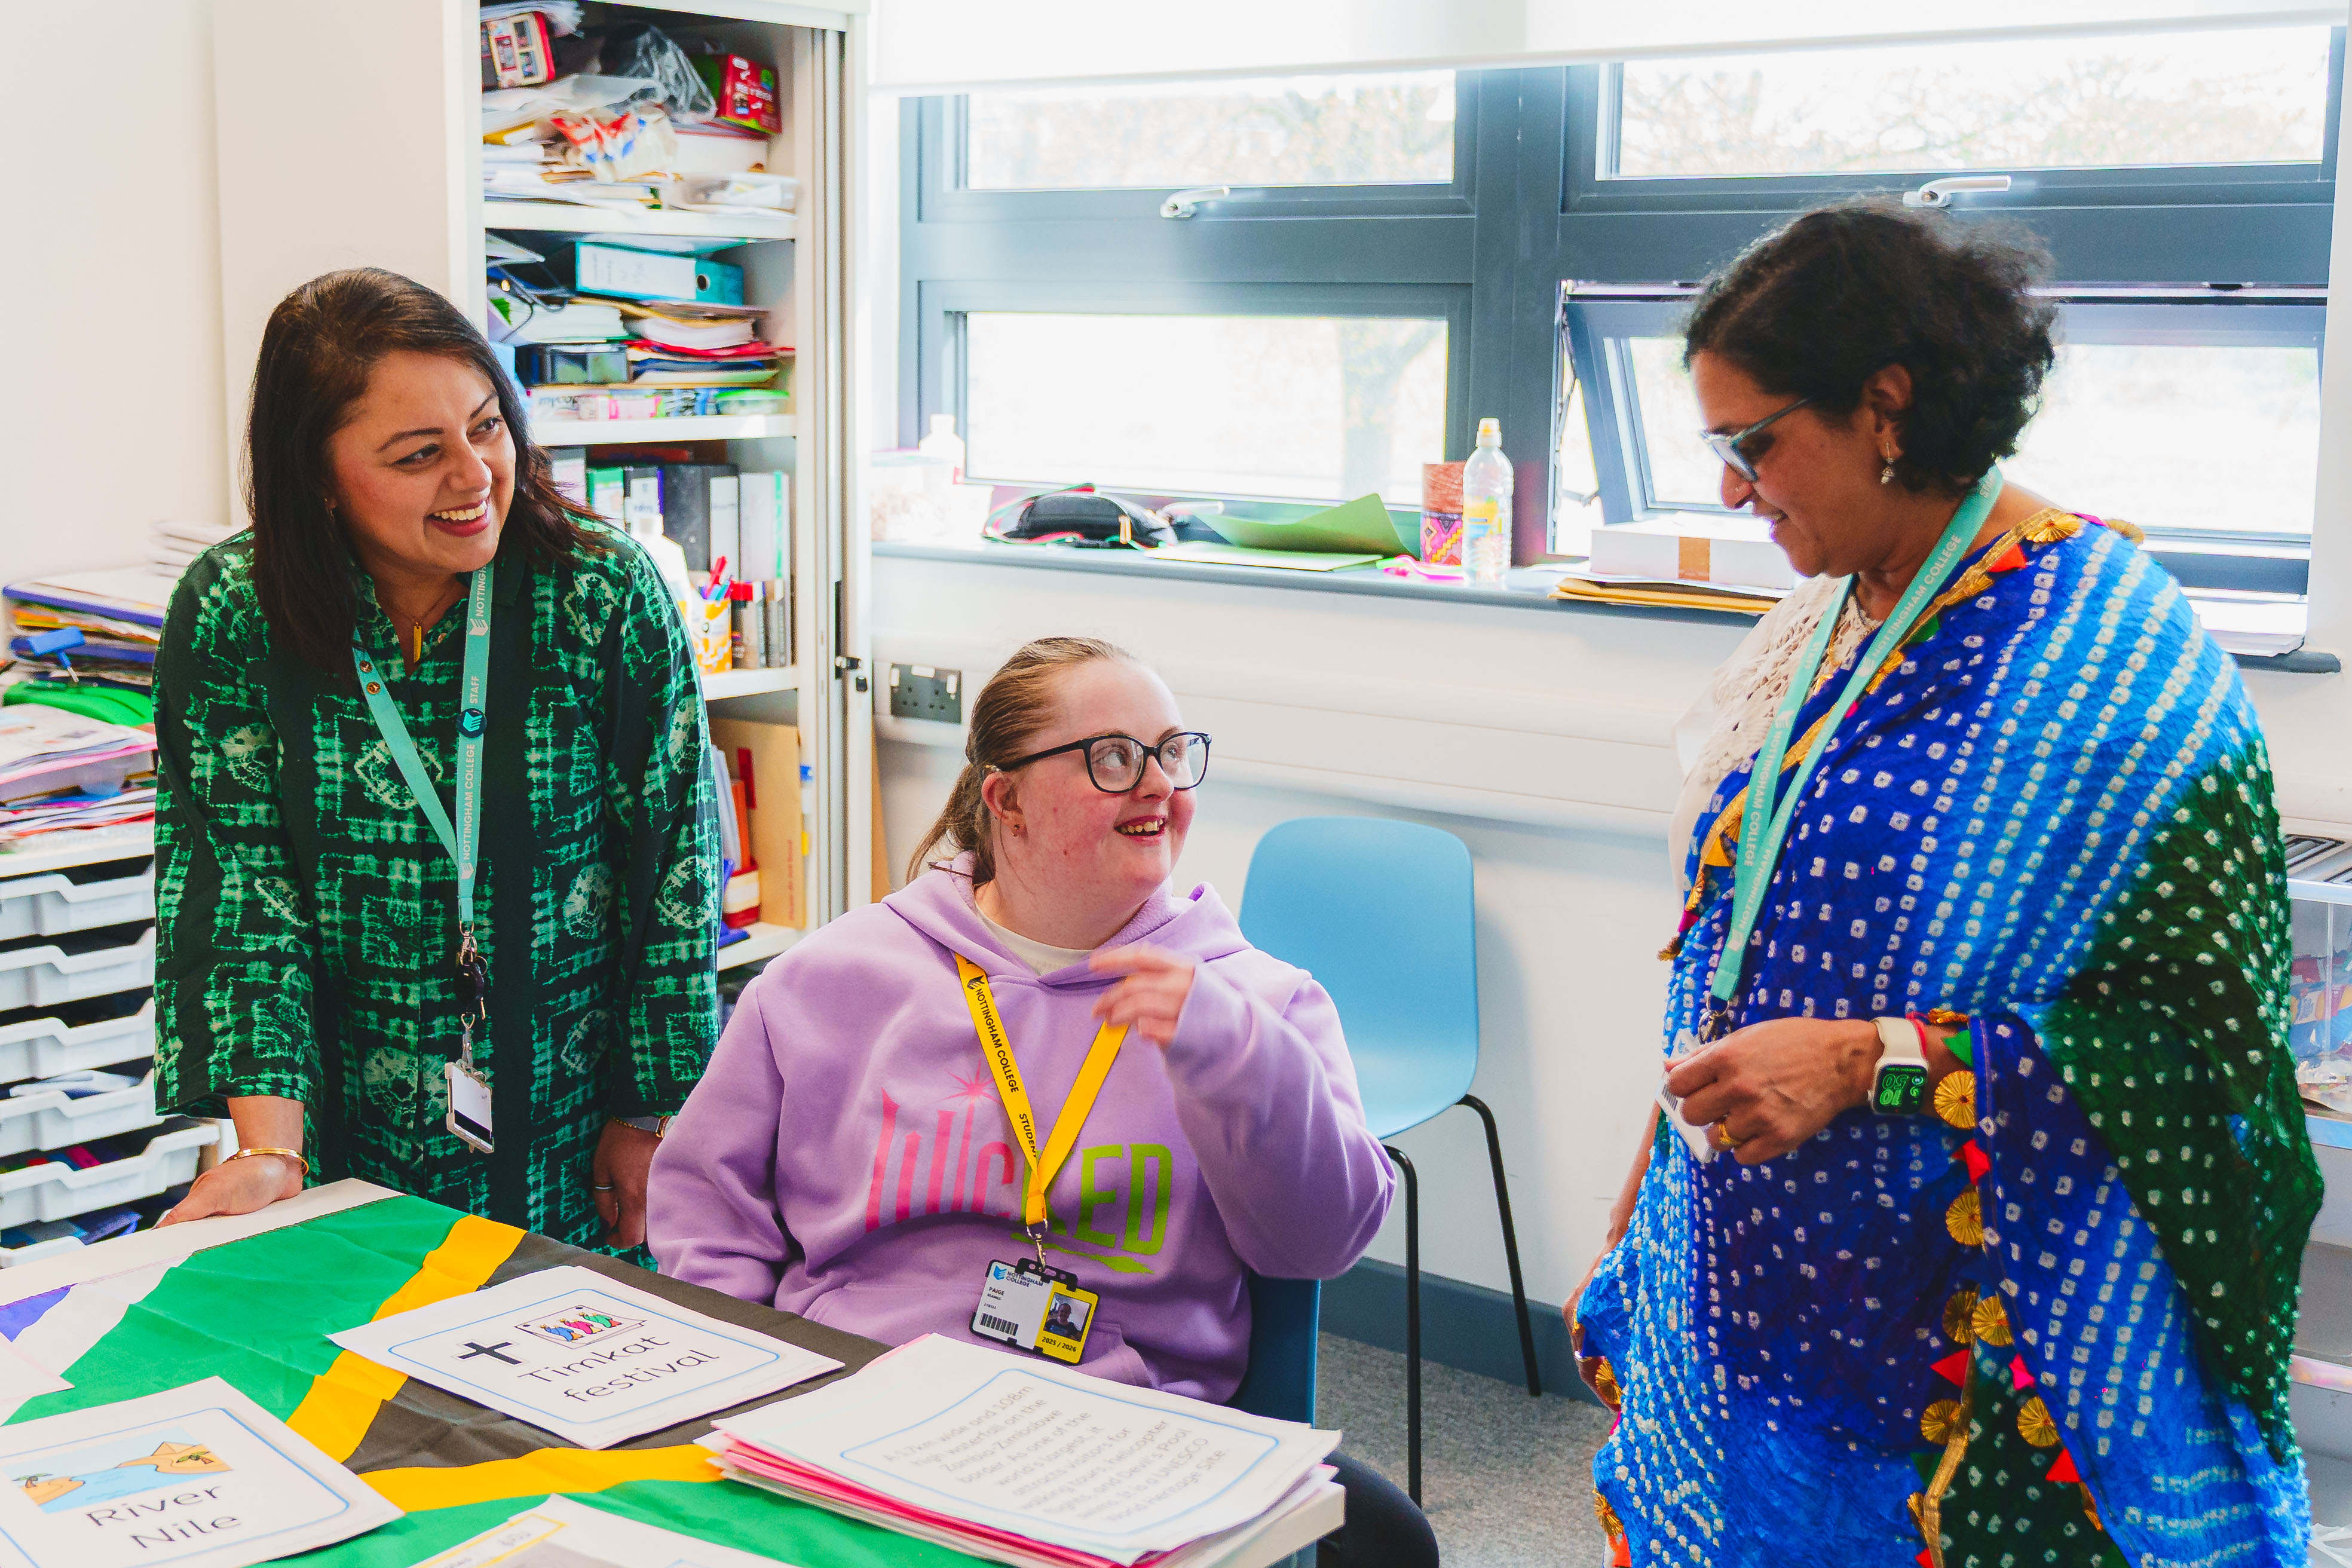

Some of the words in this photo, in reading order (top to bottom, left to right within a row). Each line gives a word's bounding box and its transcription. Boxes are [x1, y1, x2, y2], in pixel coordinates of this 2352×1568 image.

[1872, 584, 1927, 657] NOTTINGHAM
[1924, 535, 1962, 585] COLLEGE
[470, 676, 479, 704] STAFF
[465, 744, 475, 789] COLLEGE
[1752, 730, 1783, 810] NOTTINGHAM
[463, 792, 473, 860] NOTTINGHAM
[1744, 811, 1760, 867] COLLEGE
[1738, 849, 1771, 929] NOTTINGHAM
[975, 988, 1002, 1049] NOTTINGHAM
[997, 1049, 1019, 1093] COLLEGE
[988, 1287, 1004, 1296] PAIGE
[1006, 1276, 1030, 1287] COLLEGE
[1007, 1271, 1043, 1287] NOTTINGHAM
[518, 1334, 671, 1383] Timkat
[1042, 1336, 1057, 1346] 2025
[1062, 1343, 1077, 1352] 2026
[564, 1348, 720, 1404] festival
[938, 1425, 970, 1443] wide
[969, 1408, 997, 1426] and
[993, 1385, 1035, 1410] 108m
[1004, 1412, 1025, 1426] on
[1020, 1398, 1048, 1414] the
[1025, 1434, 1055, 1453] one
[1051, 1424, 1068, 1437] of
[1064, 1410, 1092, 1428] the
[1106, 1425, 1133, 1442] for
[1104, 1419, 1171, 1466] helicopter
[1151, 1437, 1209, 1478] UNESCO
[1156, 1427, 1193, 1453] Pool
[85, 1483, 223, 1527] River
[1142, 1470, 1203, 1506] Heritage
[130, 1515, 242, 1549] Nile
